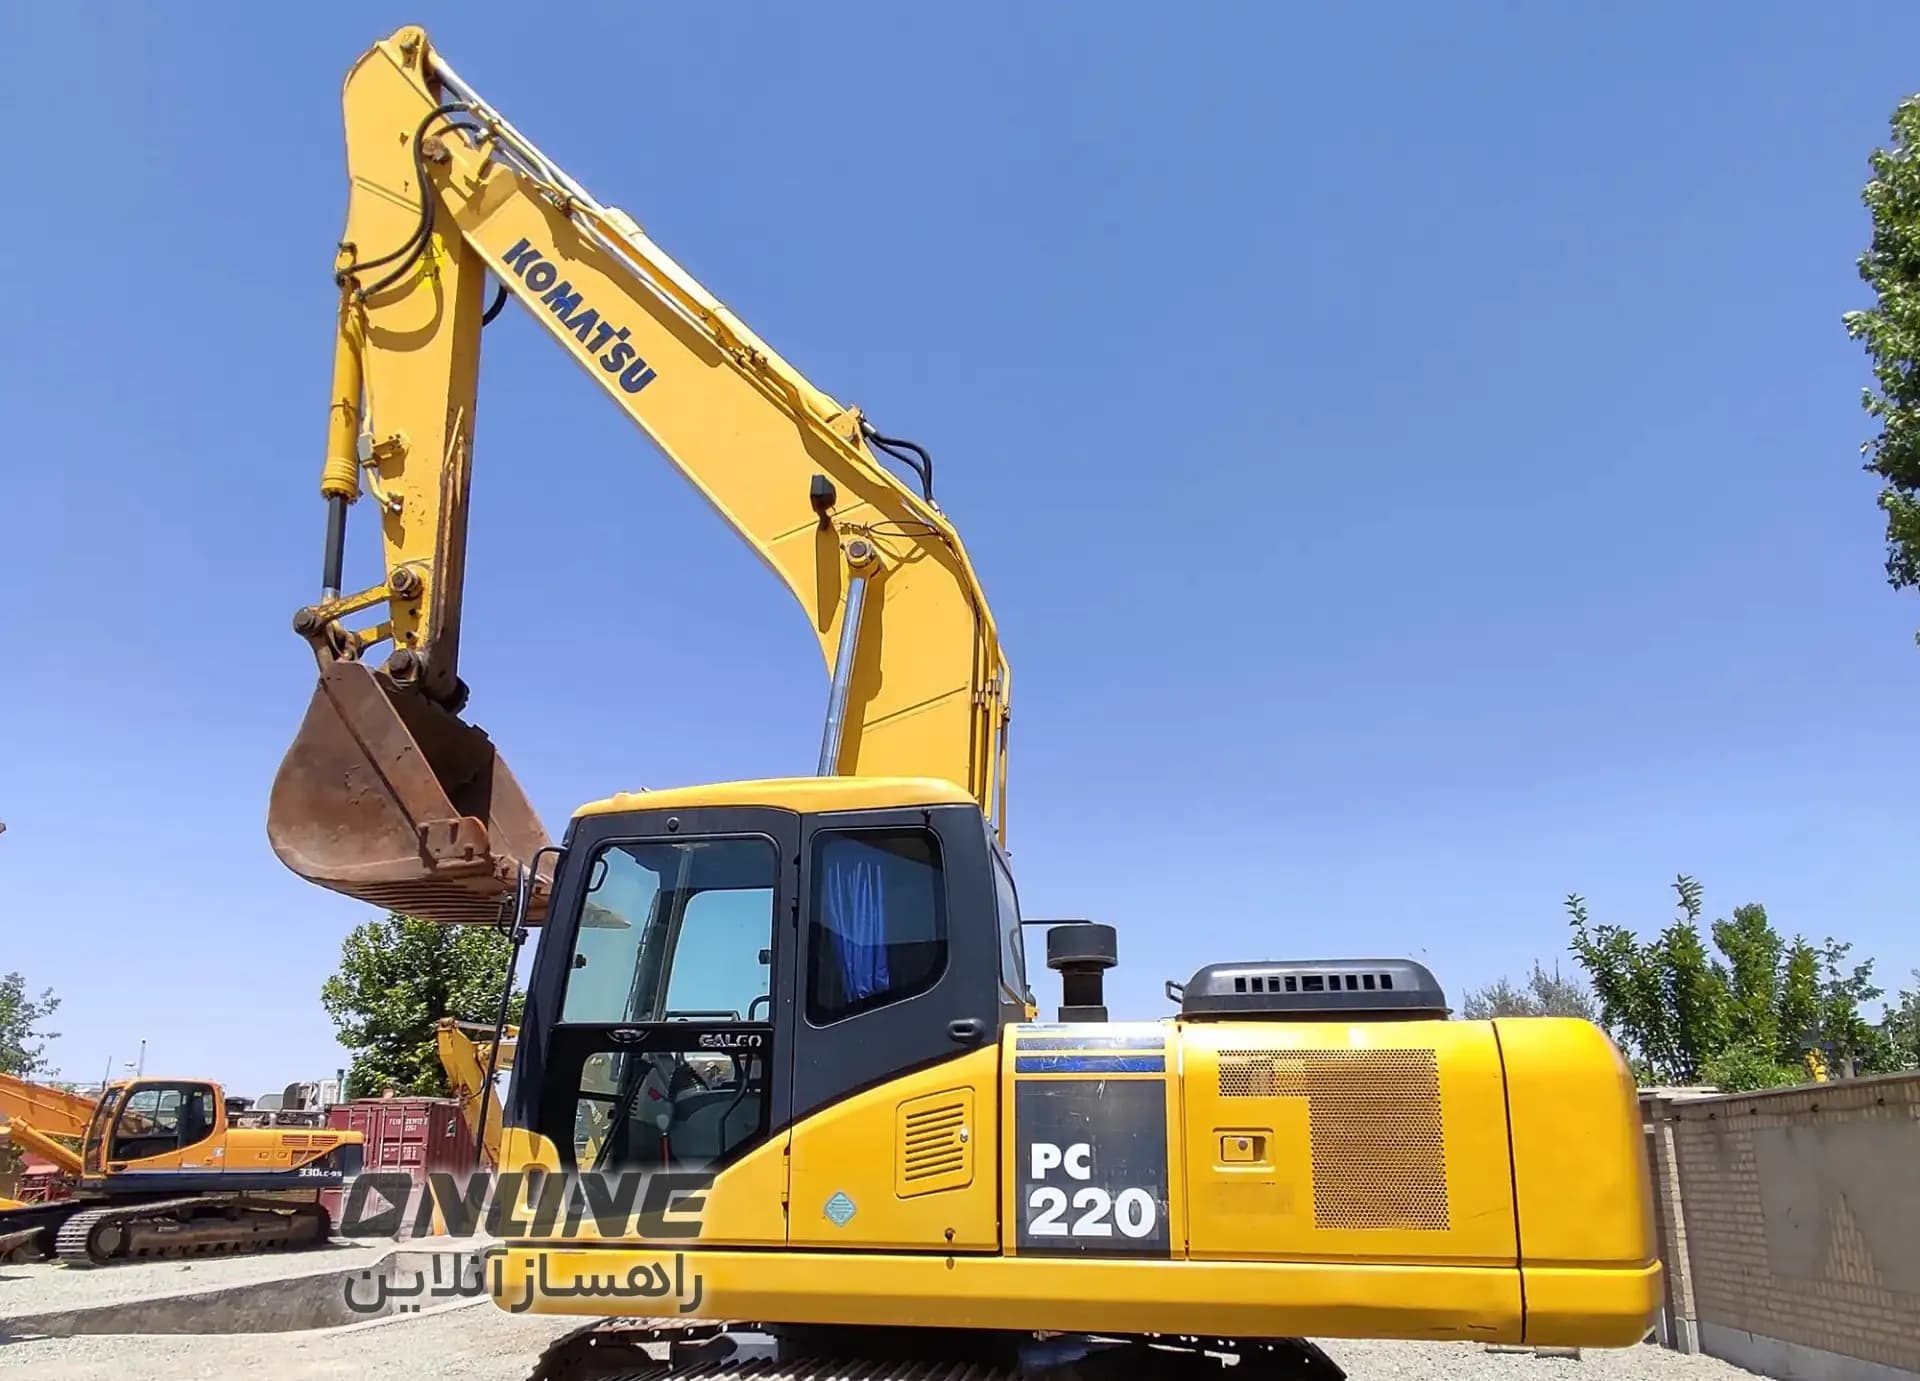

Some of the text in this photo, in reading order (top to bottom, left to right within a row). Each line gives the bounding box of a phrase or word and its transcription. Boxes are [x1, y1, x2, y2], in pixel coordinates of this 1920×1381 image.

[502, 238, 657, 393] KOMATSU
[1031, 1143, 1091, 1180] PC
[1028, 1187, 1156, 1238] 220
